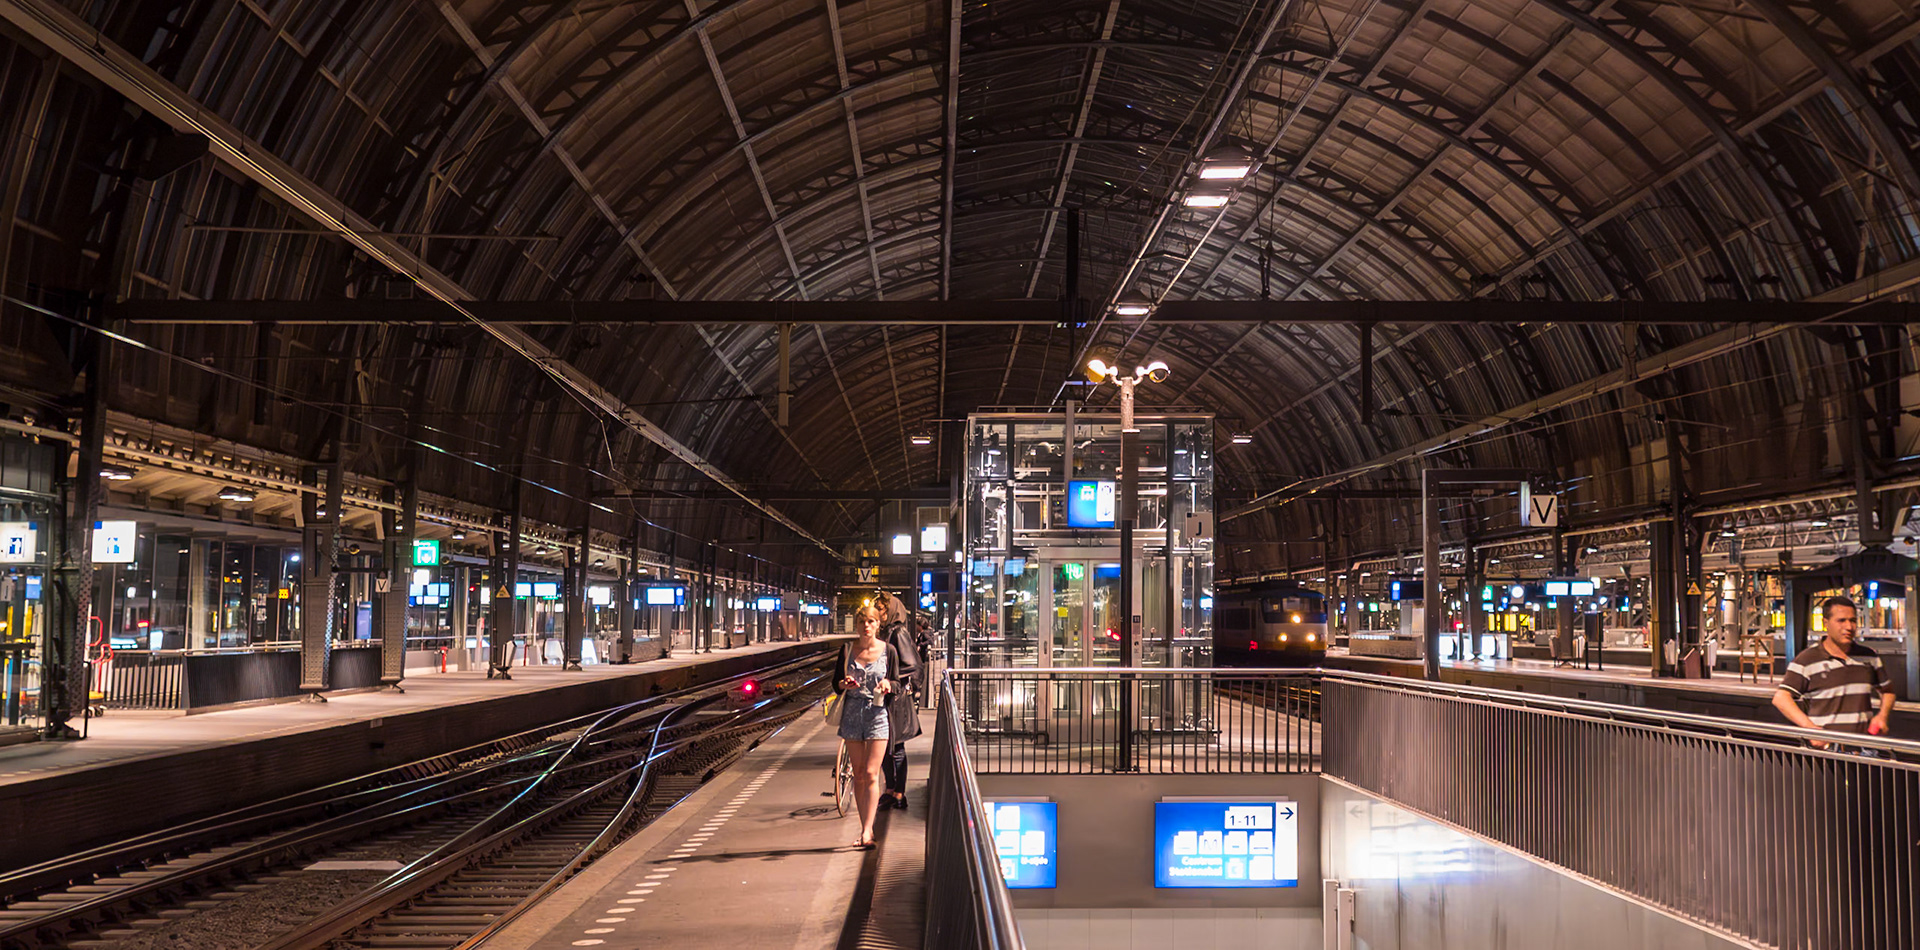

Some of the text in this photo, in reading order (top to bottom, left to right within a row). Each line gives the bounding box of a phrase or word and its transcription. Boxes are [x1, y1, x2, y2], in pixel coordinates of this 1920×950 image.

[1532, 497, 1555, 524] V
[1195, 521, 1202, 536] J
[860, 569, 871, 581] V
[377, 580, 387, 591] V
